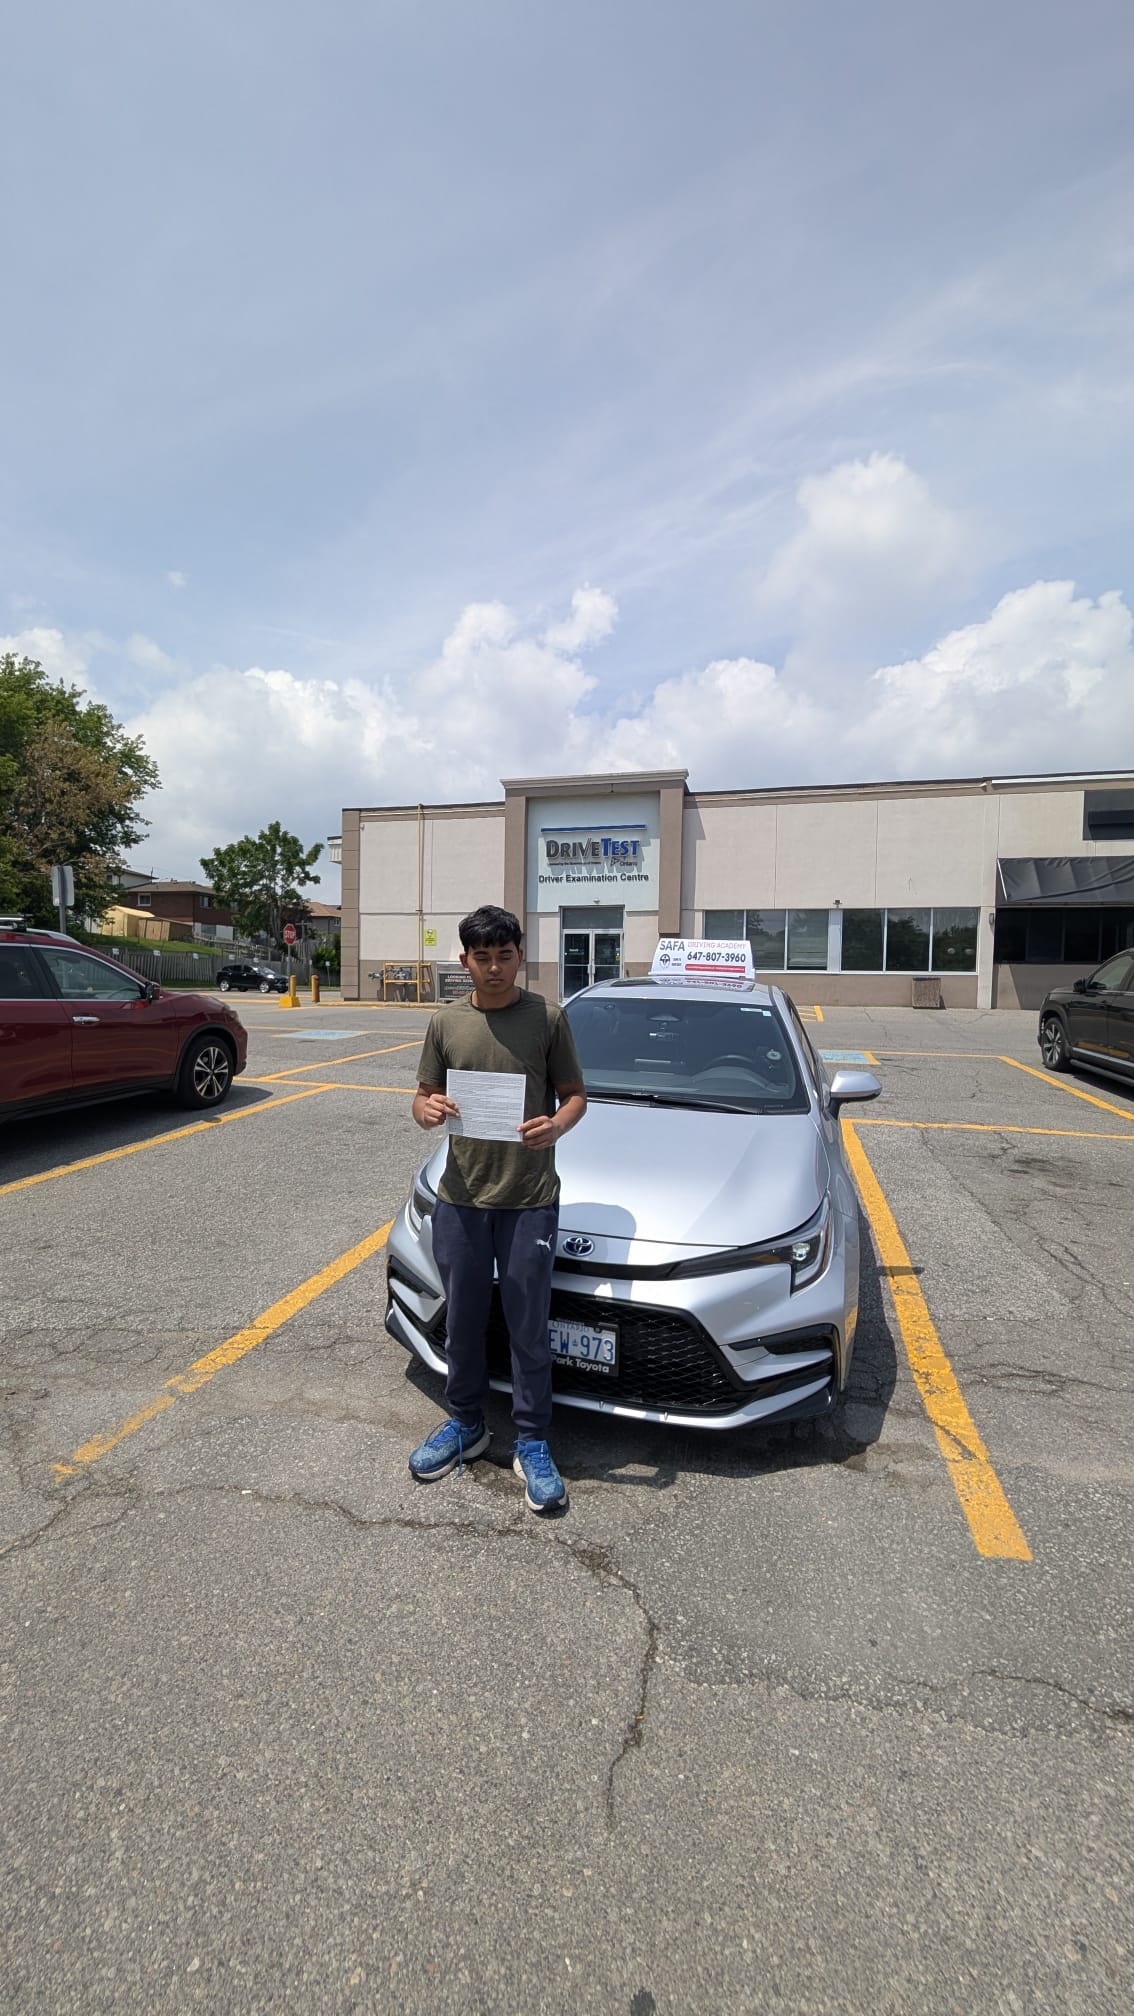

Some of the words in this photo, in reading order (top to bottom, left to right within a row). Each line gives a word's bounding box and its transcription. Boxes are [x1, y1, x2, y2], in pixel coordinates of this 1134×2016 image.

[538, 875, 563, 883] Driver
[566, 874, 618, 883] Examination
[620, 873, 649, 882] Centre
[283, 930, 296, 939] STOP
[660, 940, 685, 951] SAFA
[687, 941, 715, 949] DRIVING
[687, 951, 746, 963] 647-807-3960
[548, 1329, 569, 1354] EW
[576, 1359, 609, 1373] Toyota
